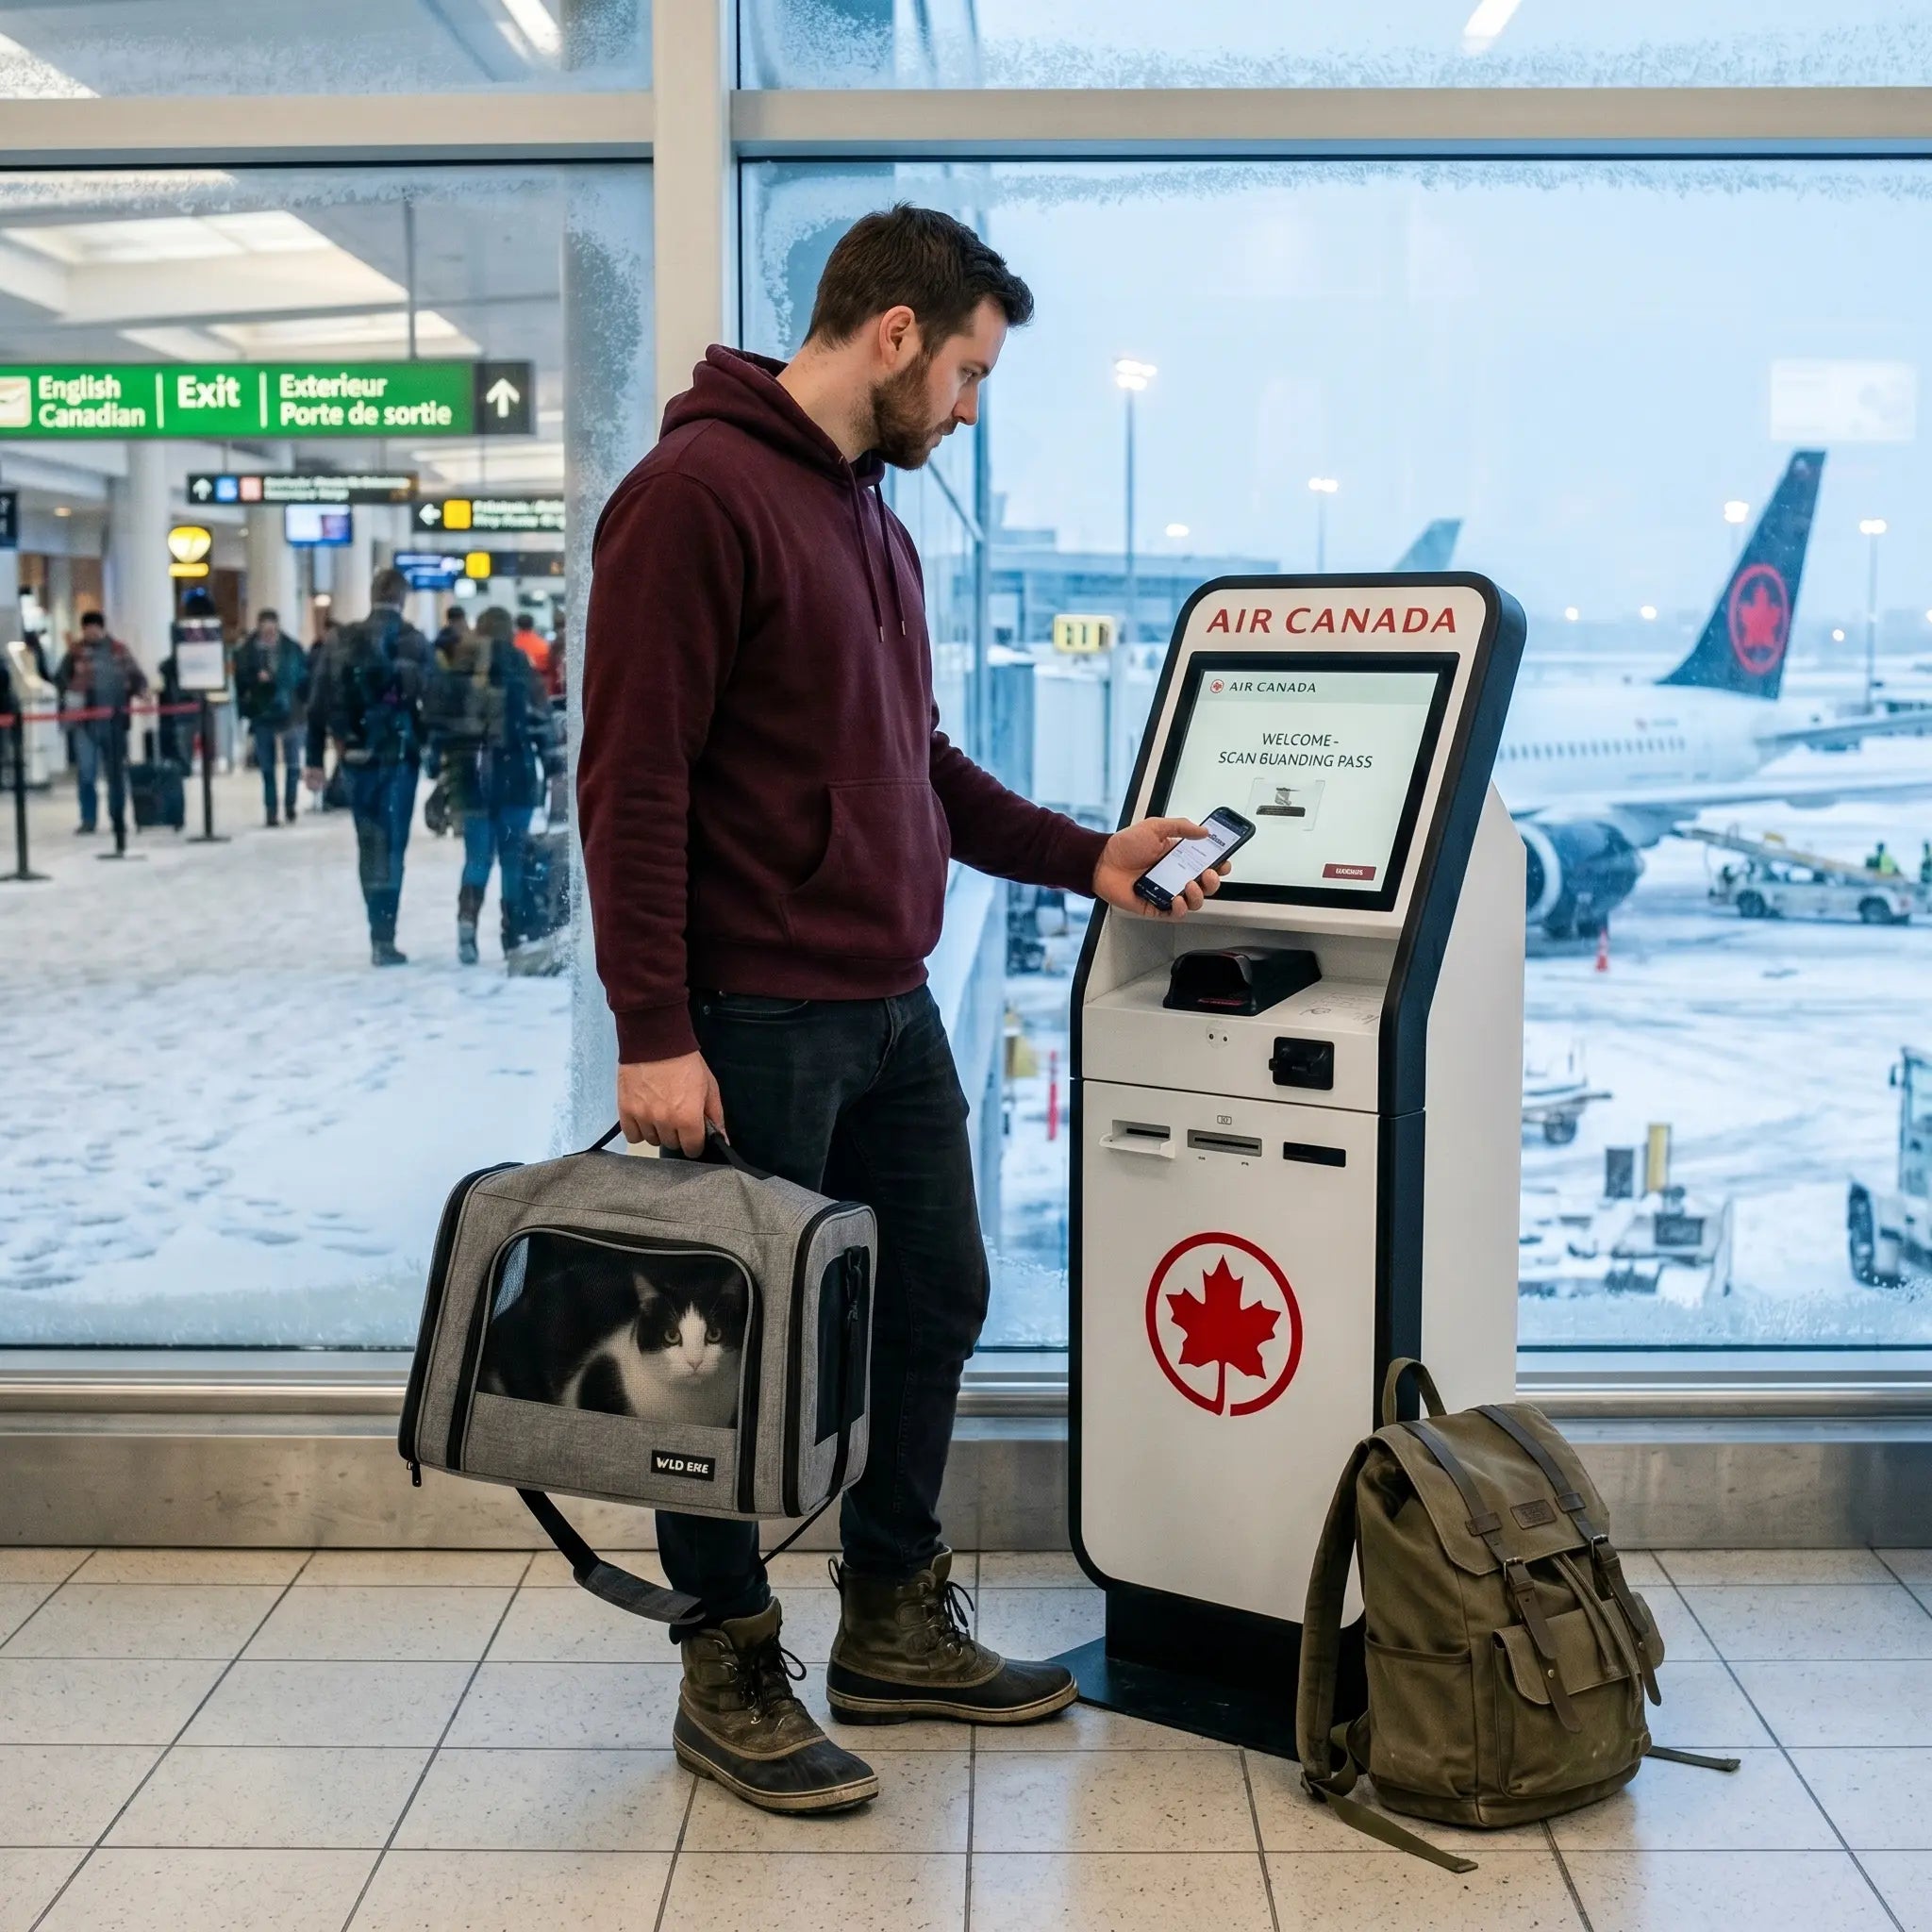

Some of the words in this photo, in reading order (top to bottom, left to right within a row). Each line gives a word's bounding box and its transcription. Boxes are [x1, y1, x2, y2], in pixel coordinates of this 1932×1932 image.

[39, 375, 121, 403] English
[178, 375, 241, 408] Exit
[279, 372, 388, 398] Exterieur
[39, 402, 145, 428] Canadian
[279, 401, 344, 426] Porte
[347, 400, 379, 426] de
[383, 400, 453, 426] sortie
[1207, 609, 1274, 633] AIR
[1286, 608, 1456, 633] CANADA
[1229, 681, 1255, 693] AIR
[1257, 682, 1316, 694] CANADA
[1218, 751, 1257, 764] SCAN
[1337, 755, 1374, 769] PASS
